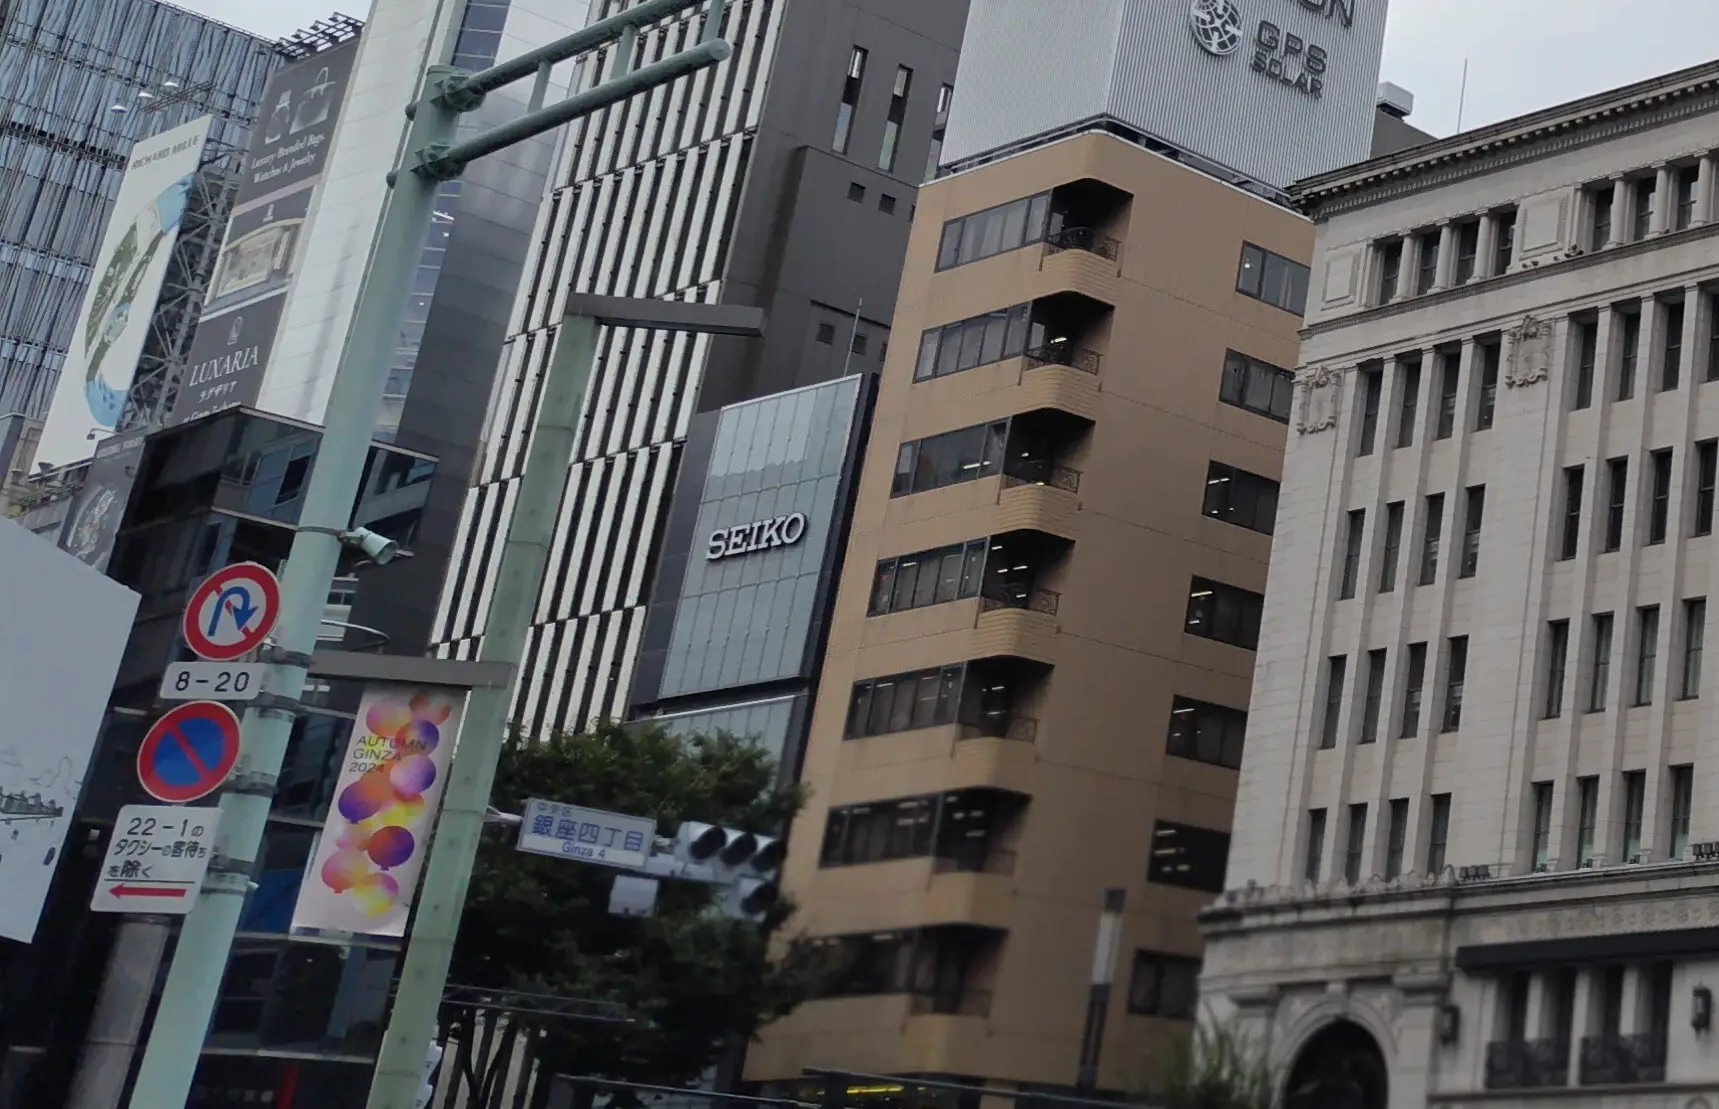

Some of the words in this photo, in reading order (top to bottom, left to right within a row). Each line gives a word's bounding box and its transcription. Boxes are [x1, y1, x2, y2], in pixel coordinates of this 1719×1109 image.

[1255, 20, 1327, 74] GPS
[1251, 50, 1323, 99] SOLAR
[189, 345, 258, 386] LUXARIA
[706, 512, 805, 560] SEIKO
[175, 671, 249, 692] 8-20
[357, 736, 427, 750] AUTUMN
[353, 748, 402, 760] GINZA
[349, 762, 384, 773] 2024
[532, 814, 643, 851] 銀座四丁目
[114, 838, 206, 859] タクシーの客待ち
[562, 841, 594, 857] Ginza
[598, 848, 606, 858] 4
[108, 860, 152, 879] を除く
